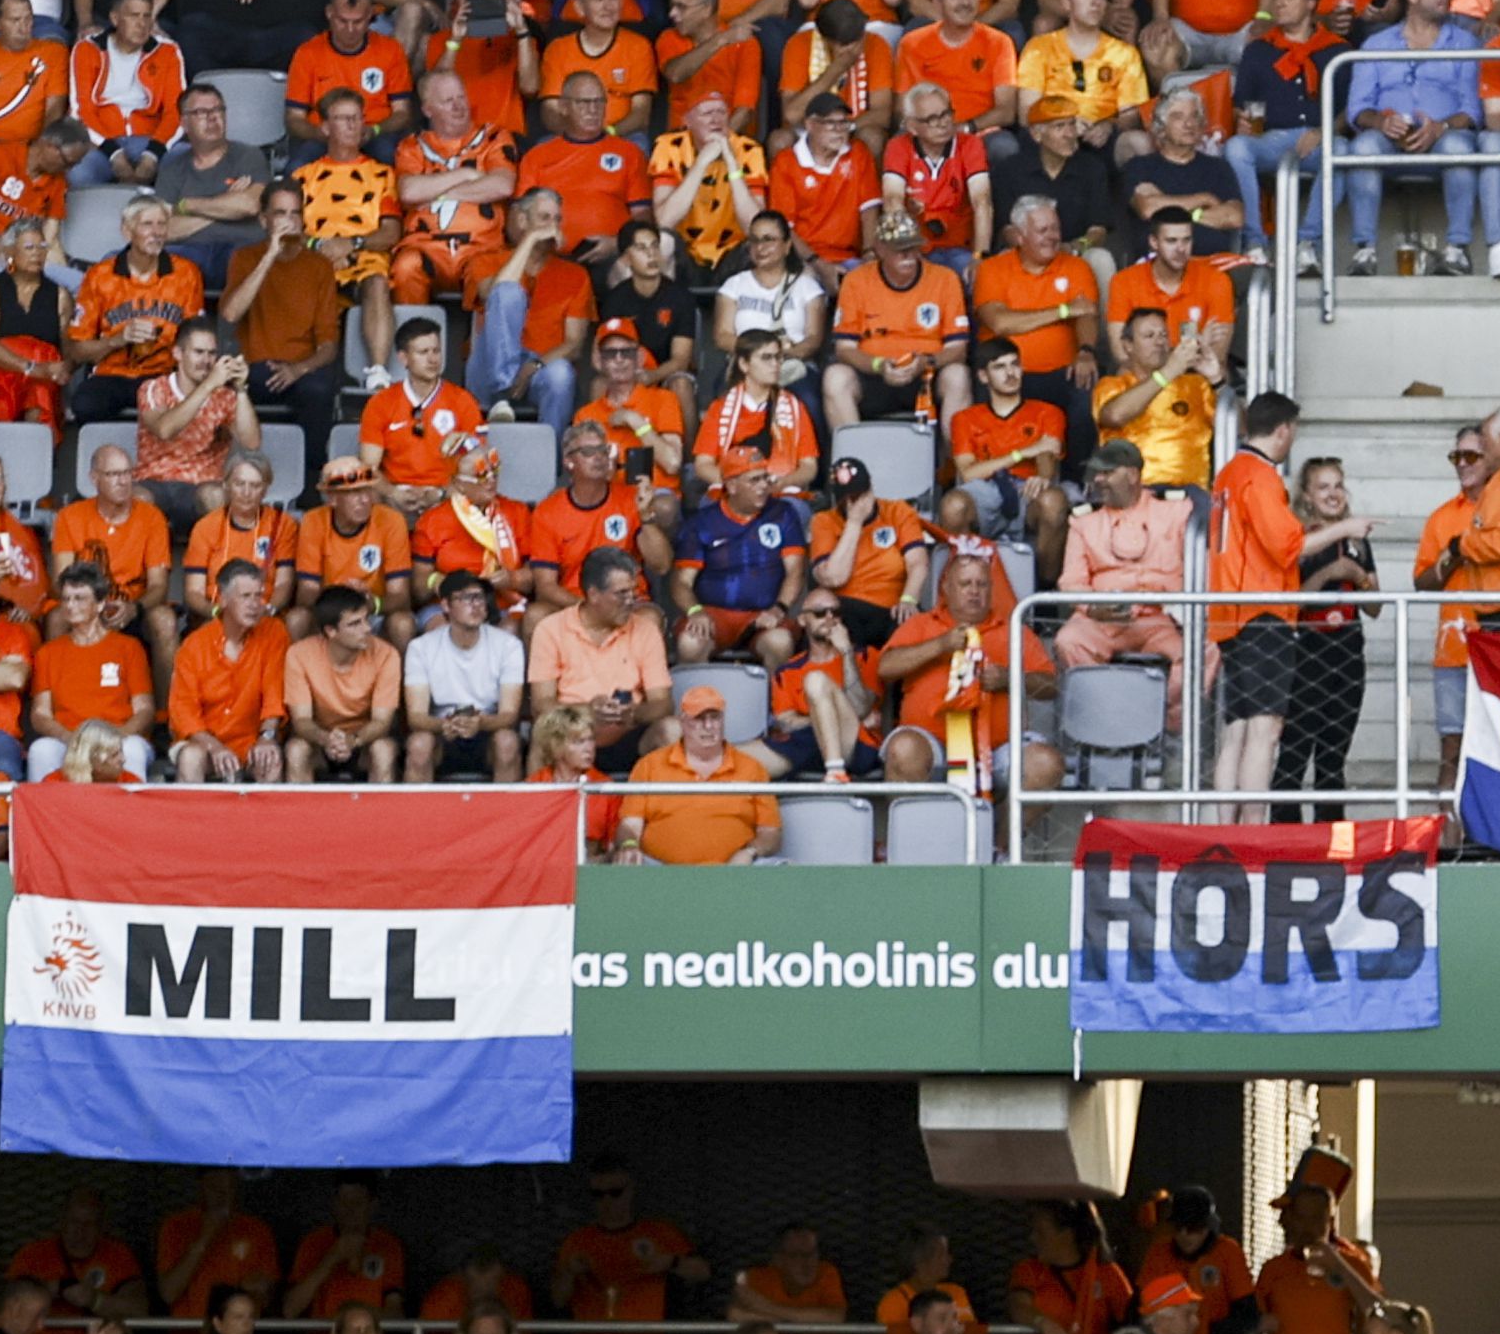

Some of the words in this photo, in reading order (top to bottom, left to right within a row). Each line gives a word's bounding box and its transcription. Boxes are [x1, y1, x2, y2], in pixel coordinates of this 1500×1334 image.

[0, 175, 26, 201] 88
[105, 298, 184, 326] HOLLAND
[124, 923, 456, 1023] MILL
[644, 940, 977, 988] nealkoholinis
[992, 941, 1070, 988] alu
[42, 1000, 97, 1022] KNVB
